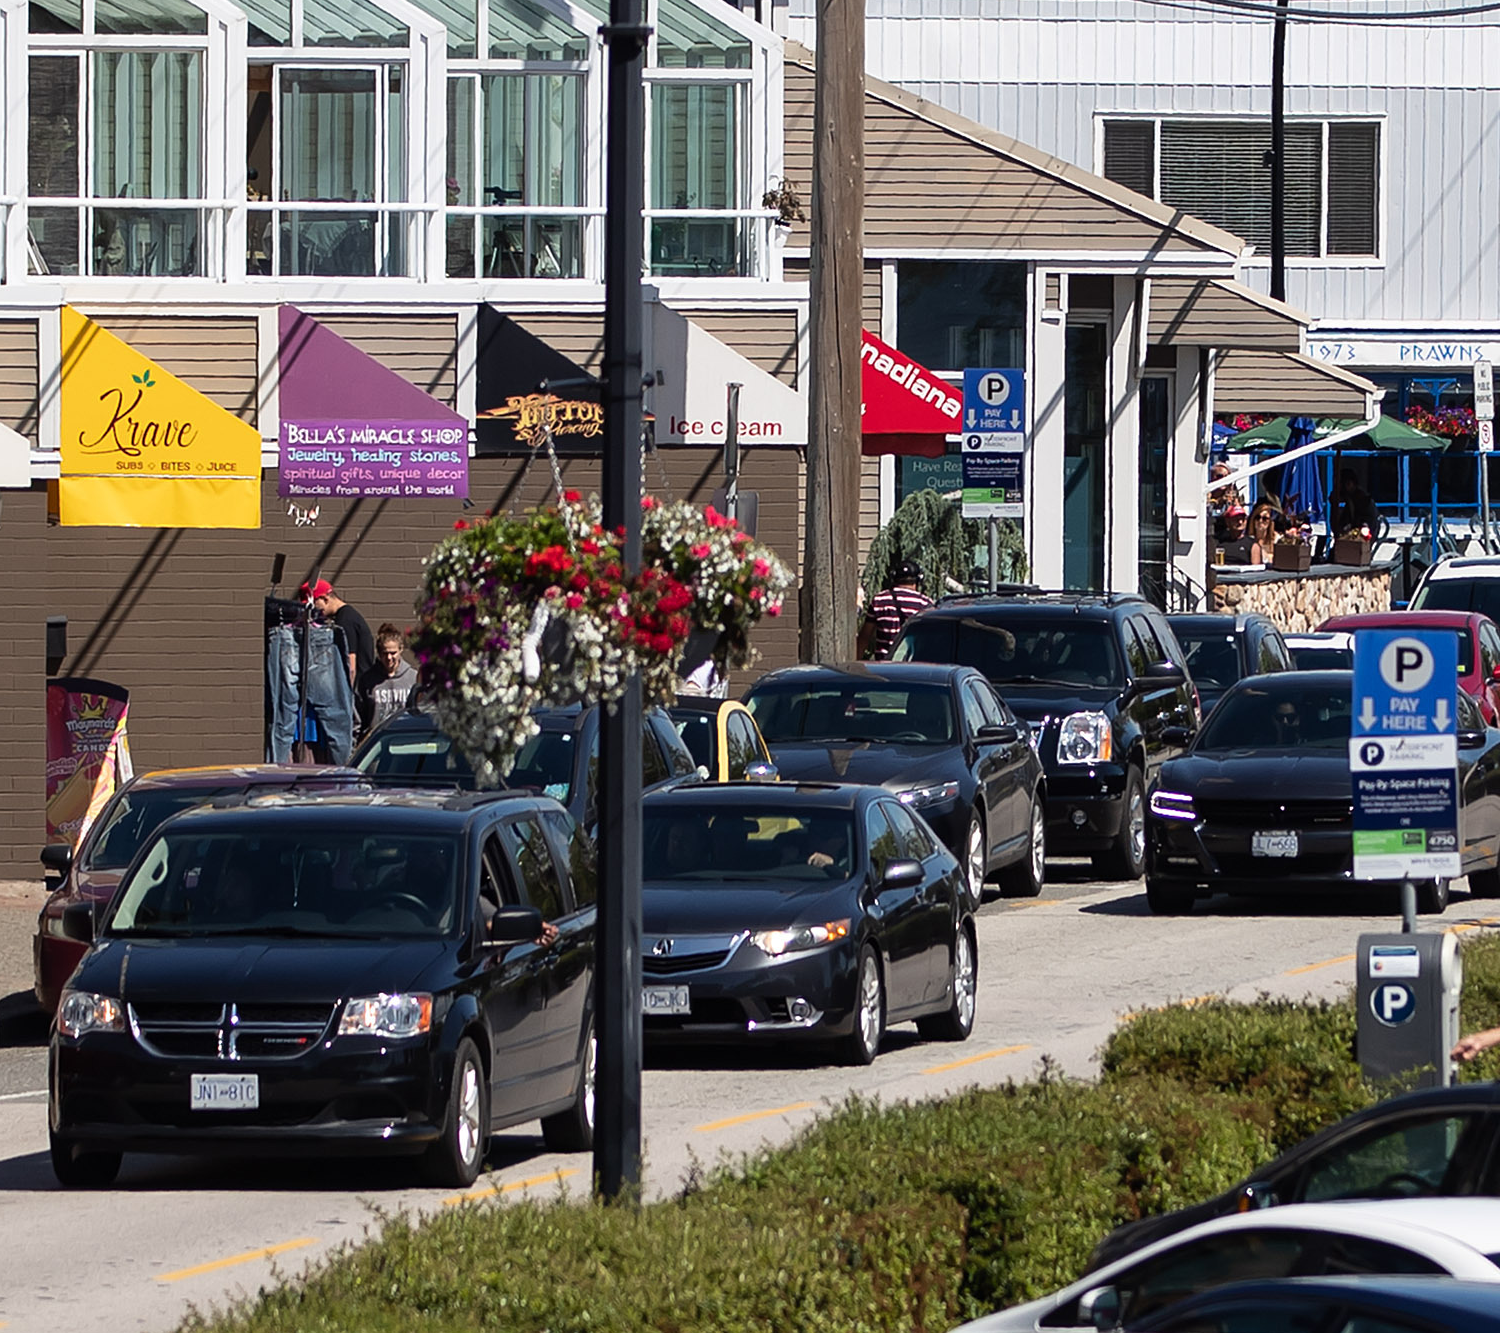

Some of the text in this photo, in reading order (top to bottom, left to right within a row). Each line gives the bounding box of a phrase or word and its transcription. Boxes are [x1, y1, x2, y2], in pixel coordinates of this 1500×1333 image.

[1308, 344, 1357, 361] 1973
[1400, 345, 1484, 361] PRAWNS
[861, 340, 963, 419] nadiana
[987, 378, 1005, 401] P
[984, 409, 1002, 417] PAY
[79, 388, 198, 457] Krave
[670, 416, 782, 437] Ice ceam
[980, 418, 1007, 428] HERE
[287, 424, 463, 445] BELLA'S MIRACLE SHOP
[287, 447, 462, 466] Jewelry, healing stones,
[116, 461, 237, 473] SUBS BITES JUICE
[283, 468, 336, 481] spiritual
[379, 469, 422, 483] unique
[427, 469, 465, 480] decor
[913, 461, 941, 473] Have
[288, 485, 454, 495] Miracles from around the world
[1395, 646, 1424, 683] P
[1390, 697, 1420, 713] PAY
[1382, 715, 1428, 730] HERE
[1366, 746, 1378, 763] P
